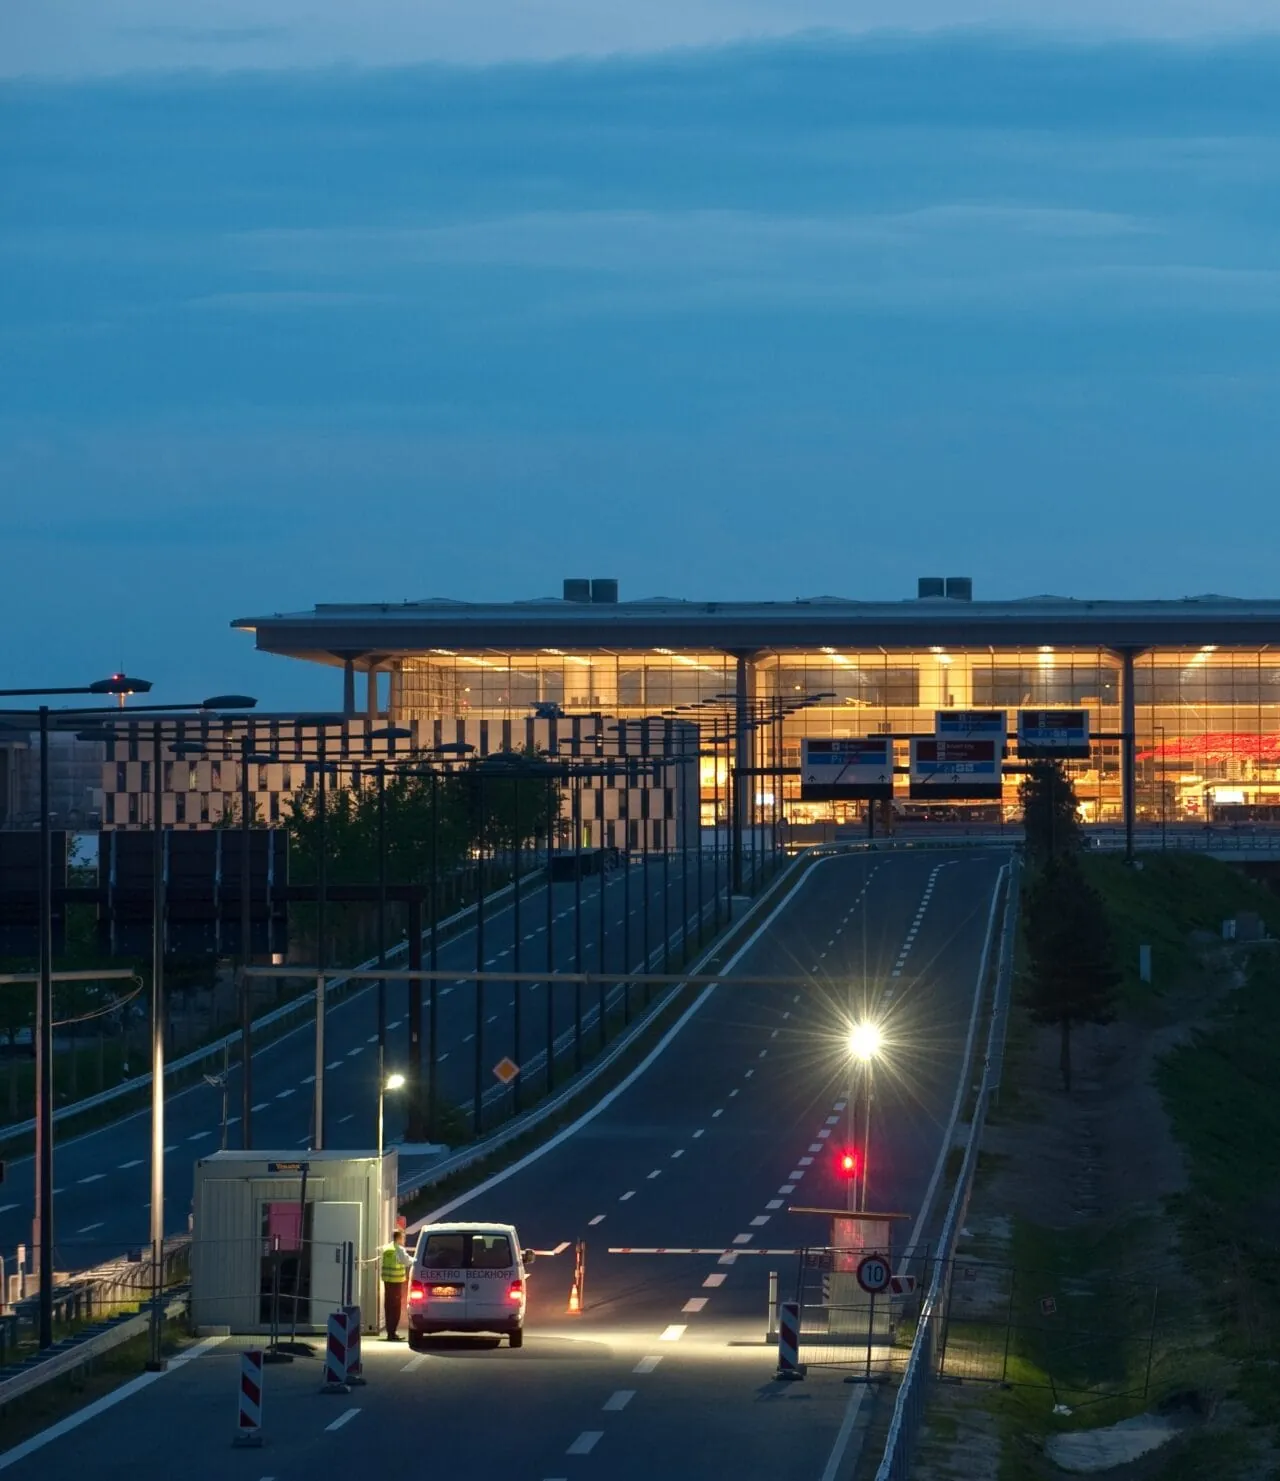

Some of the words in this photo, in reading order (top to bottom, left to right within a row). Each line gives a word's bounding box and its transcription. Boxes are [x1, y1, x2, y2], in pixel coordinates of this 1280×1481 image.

[420, 1270, 461, 1280] ELEKTRO
[466, 1270, 514, 1280] BECKHOFF
[867, 1265, 883, 1282] 10
